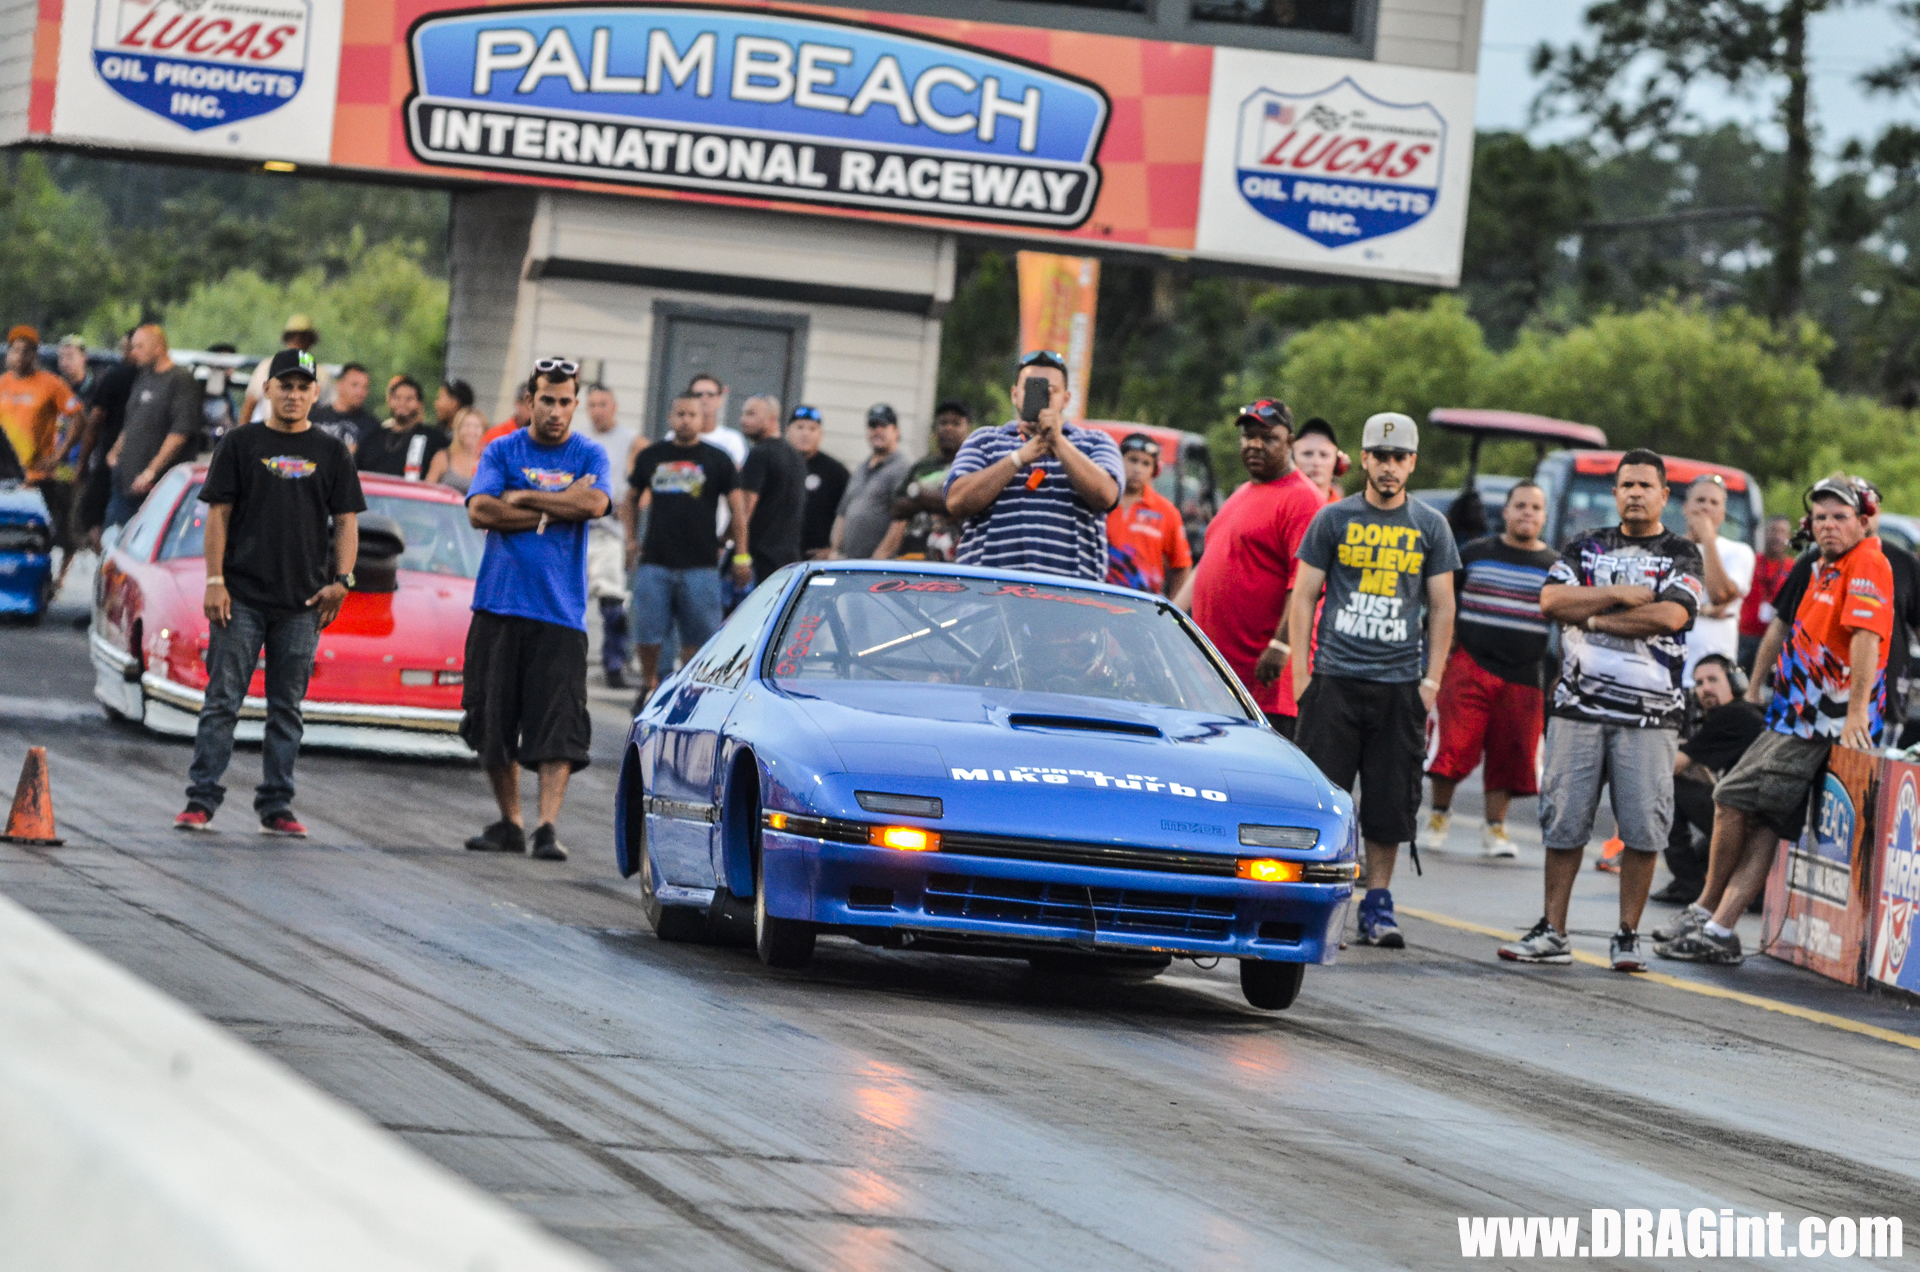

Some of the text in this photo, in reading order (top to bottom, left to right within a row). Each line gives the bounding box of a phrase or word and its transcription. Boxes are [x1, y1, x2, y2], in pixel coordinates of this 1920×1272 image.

[119, 11, 297, 61] LUCAS
[101, 56, 297, 98] OIL PRODUCTS
[473, 27, 1041, 153] PALM BEACH
[170, 91, 226, 119] INC.
[429, 108, 1079, 212] INTERNATIONAL RACEWAY
[1260, 130, 1433, 178] LUCAS
[1242, 176, 1431, 215] OIL PRODUCTS
[1307, 210, 1362, 236] INC.
[1382, 422, 1395, 438] P
[1346, 522, 1422, 551] DON'T
[1338, 544, 1424, 575] BELIEVE
[1358, 568, 1399, 597] ME
[1345, 591, 1403, 619] JUST
[1334, 609, 1407, 642] WATCH
[1084, 773, 1228, 802] Turbo
